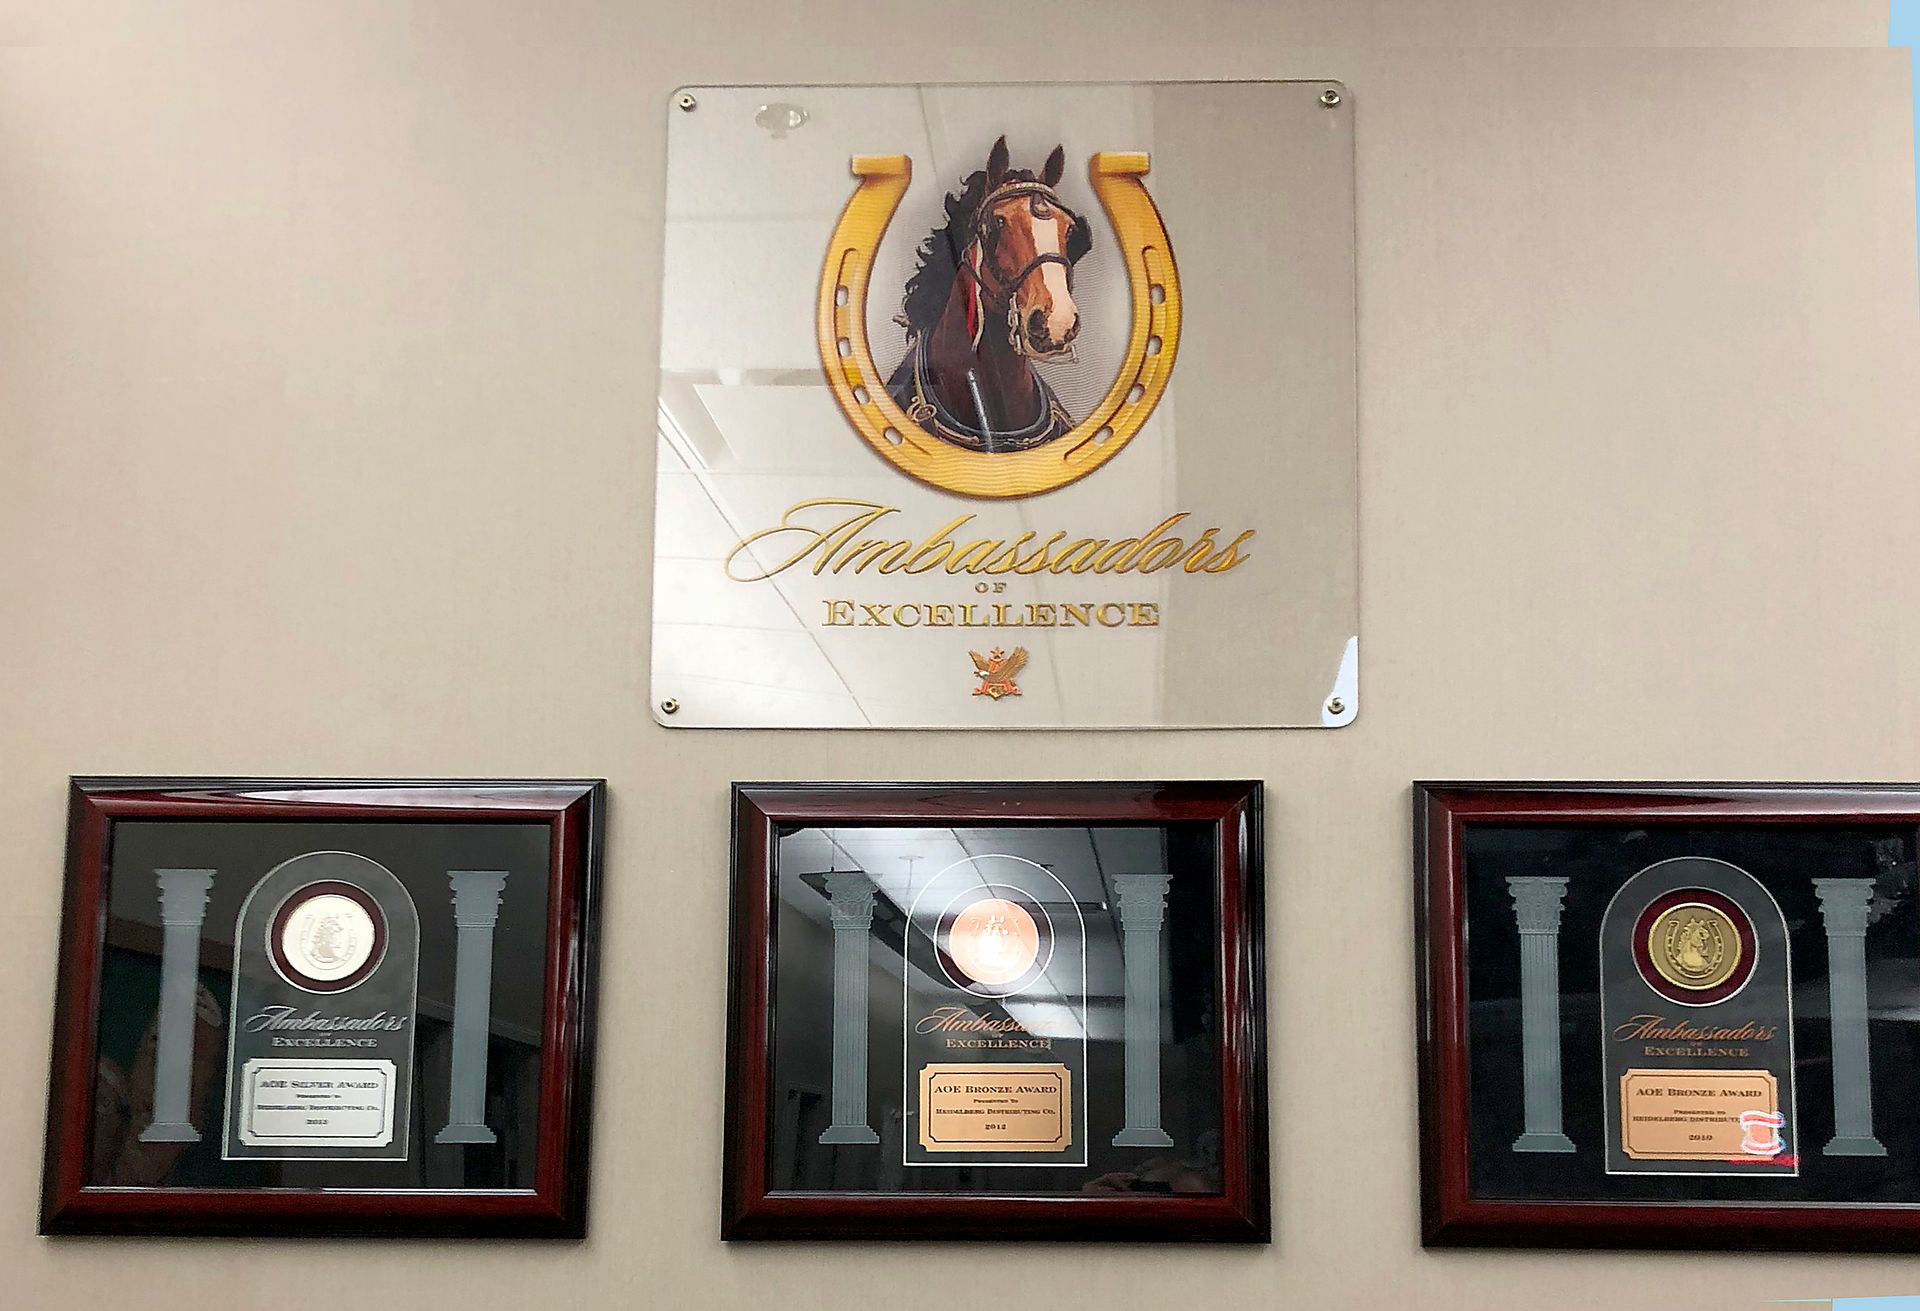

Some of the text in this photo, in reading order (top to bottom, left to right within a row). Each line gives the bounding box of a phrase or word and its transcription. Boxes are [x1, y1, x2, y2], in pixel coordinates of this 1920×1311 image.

[724, 497, 1257, 583] Ambassadors
[975, 581, 1008, 594] OF
[822, 599, 1161, 628] EXCELLENCE
[243, 1005, 408, 1033] Ambassadors
[1612, 1014, 1778, 1042] Ambassadors
[271, 1037, 378, 1048] EXCELLENCE
[945, 1038, 1050, 1049] EXCELLENCE
[1643, 1046, 1749, 1057] EXCELLENCE
[934, 1085, 1057, 1094] AOE BRONZE AWARD
[1636, 1088, 1762, 1098] AOE BRONZE AWARD
